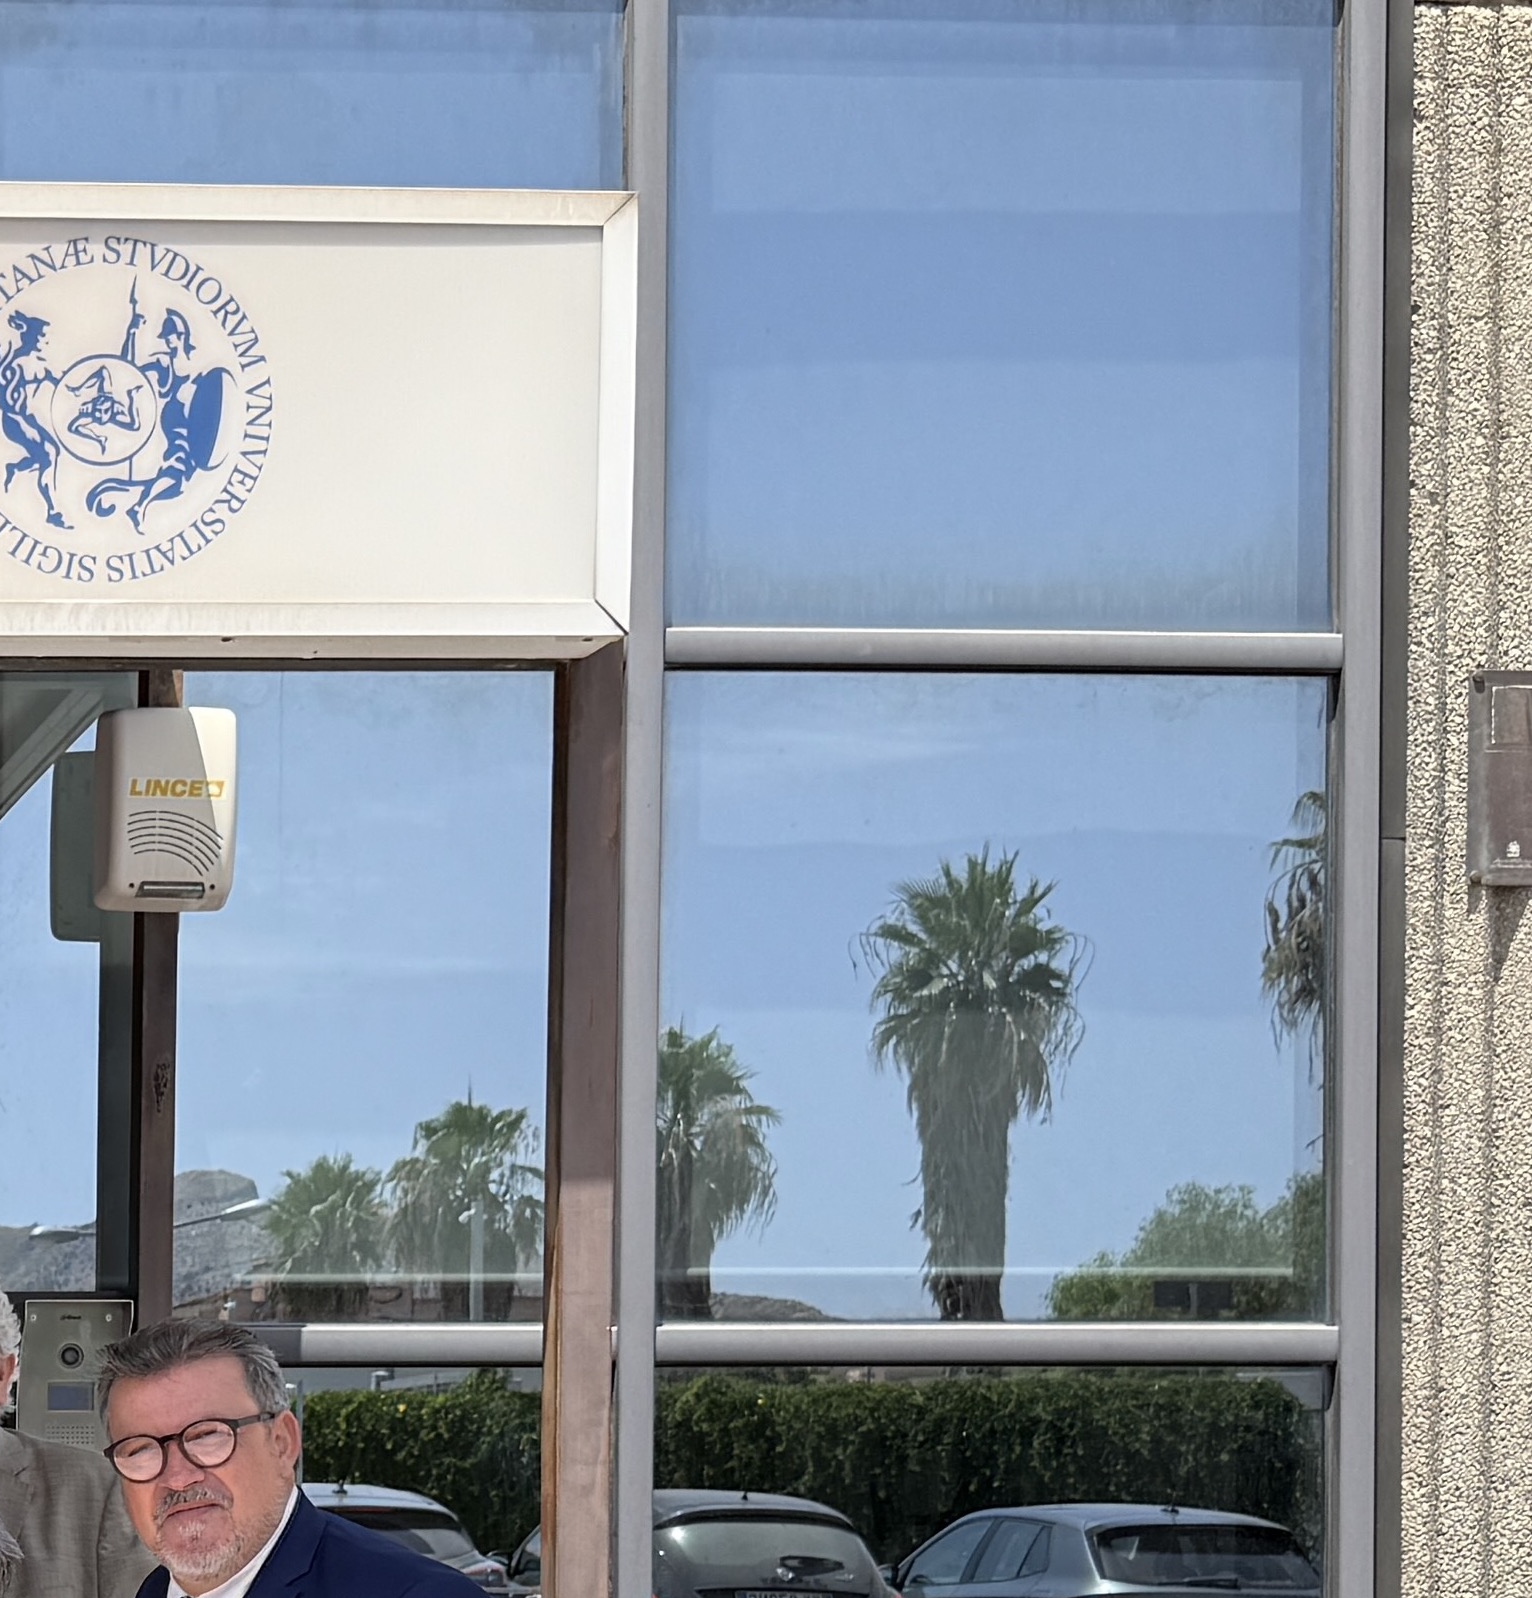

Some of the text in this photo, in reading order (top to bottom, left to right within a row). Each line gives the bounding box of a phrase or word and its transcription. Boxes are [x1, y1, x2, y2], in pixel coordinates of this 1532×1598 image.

[102, 235, 269, 372] STVDIORVM
[106, 376, 273, 584] VNIVERSITATIS
[129, 778, 205, 798] LINCE
